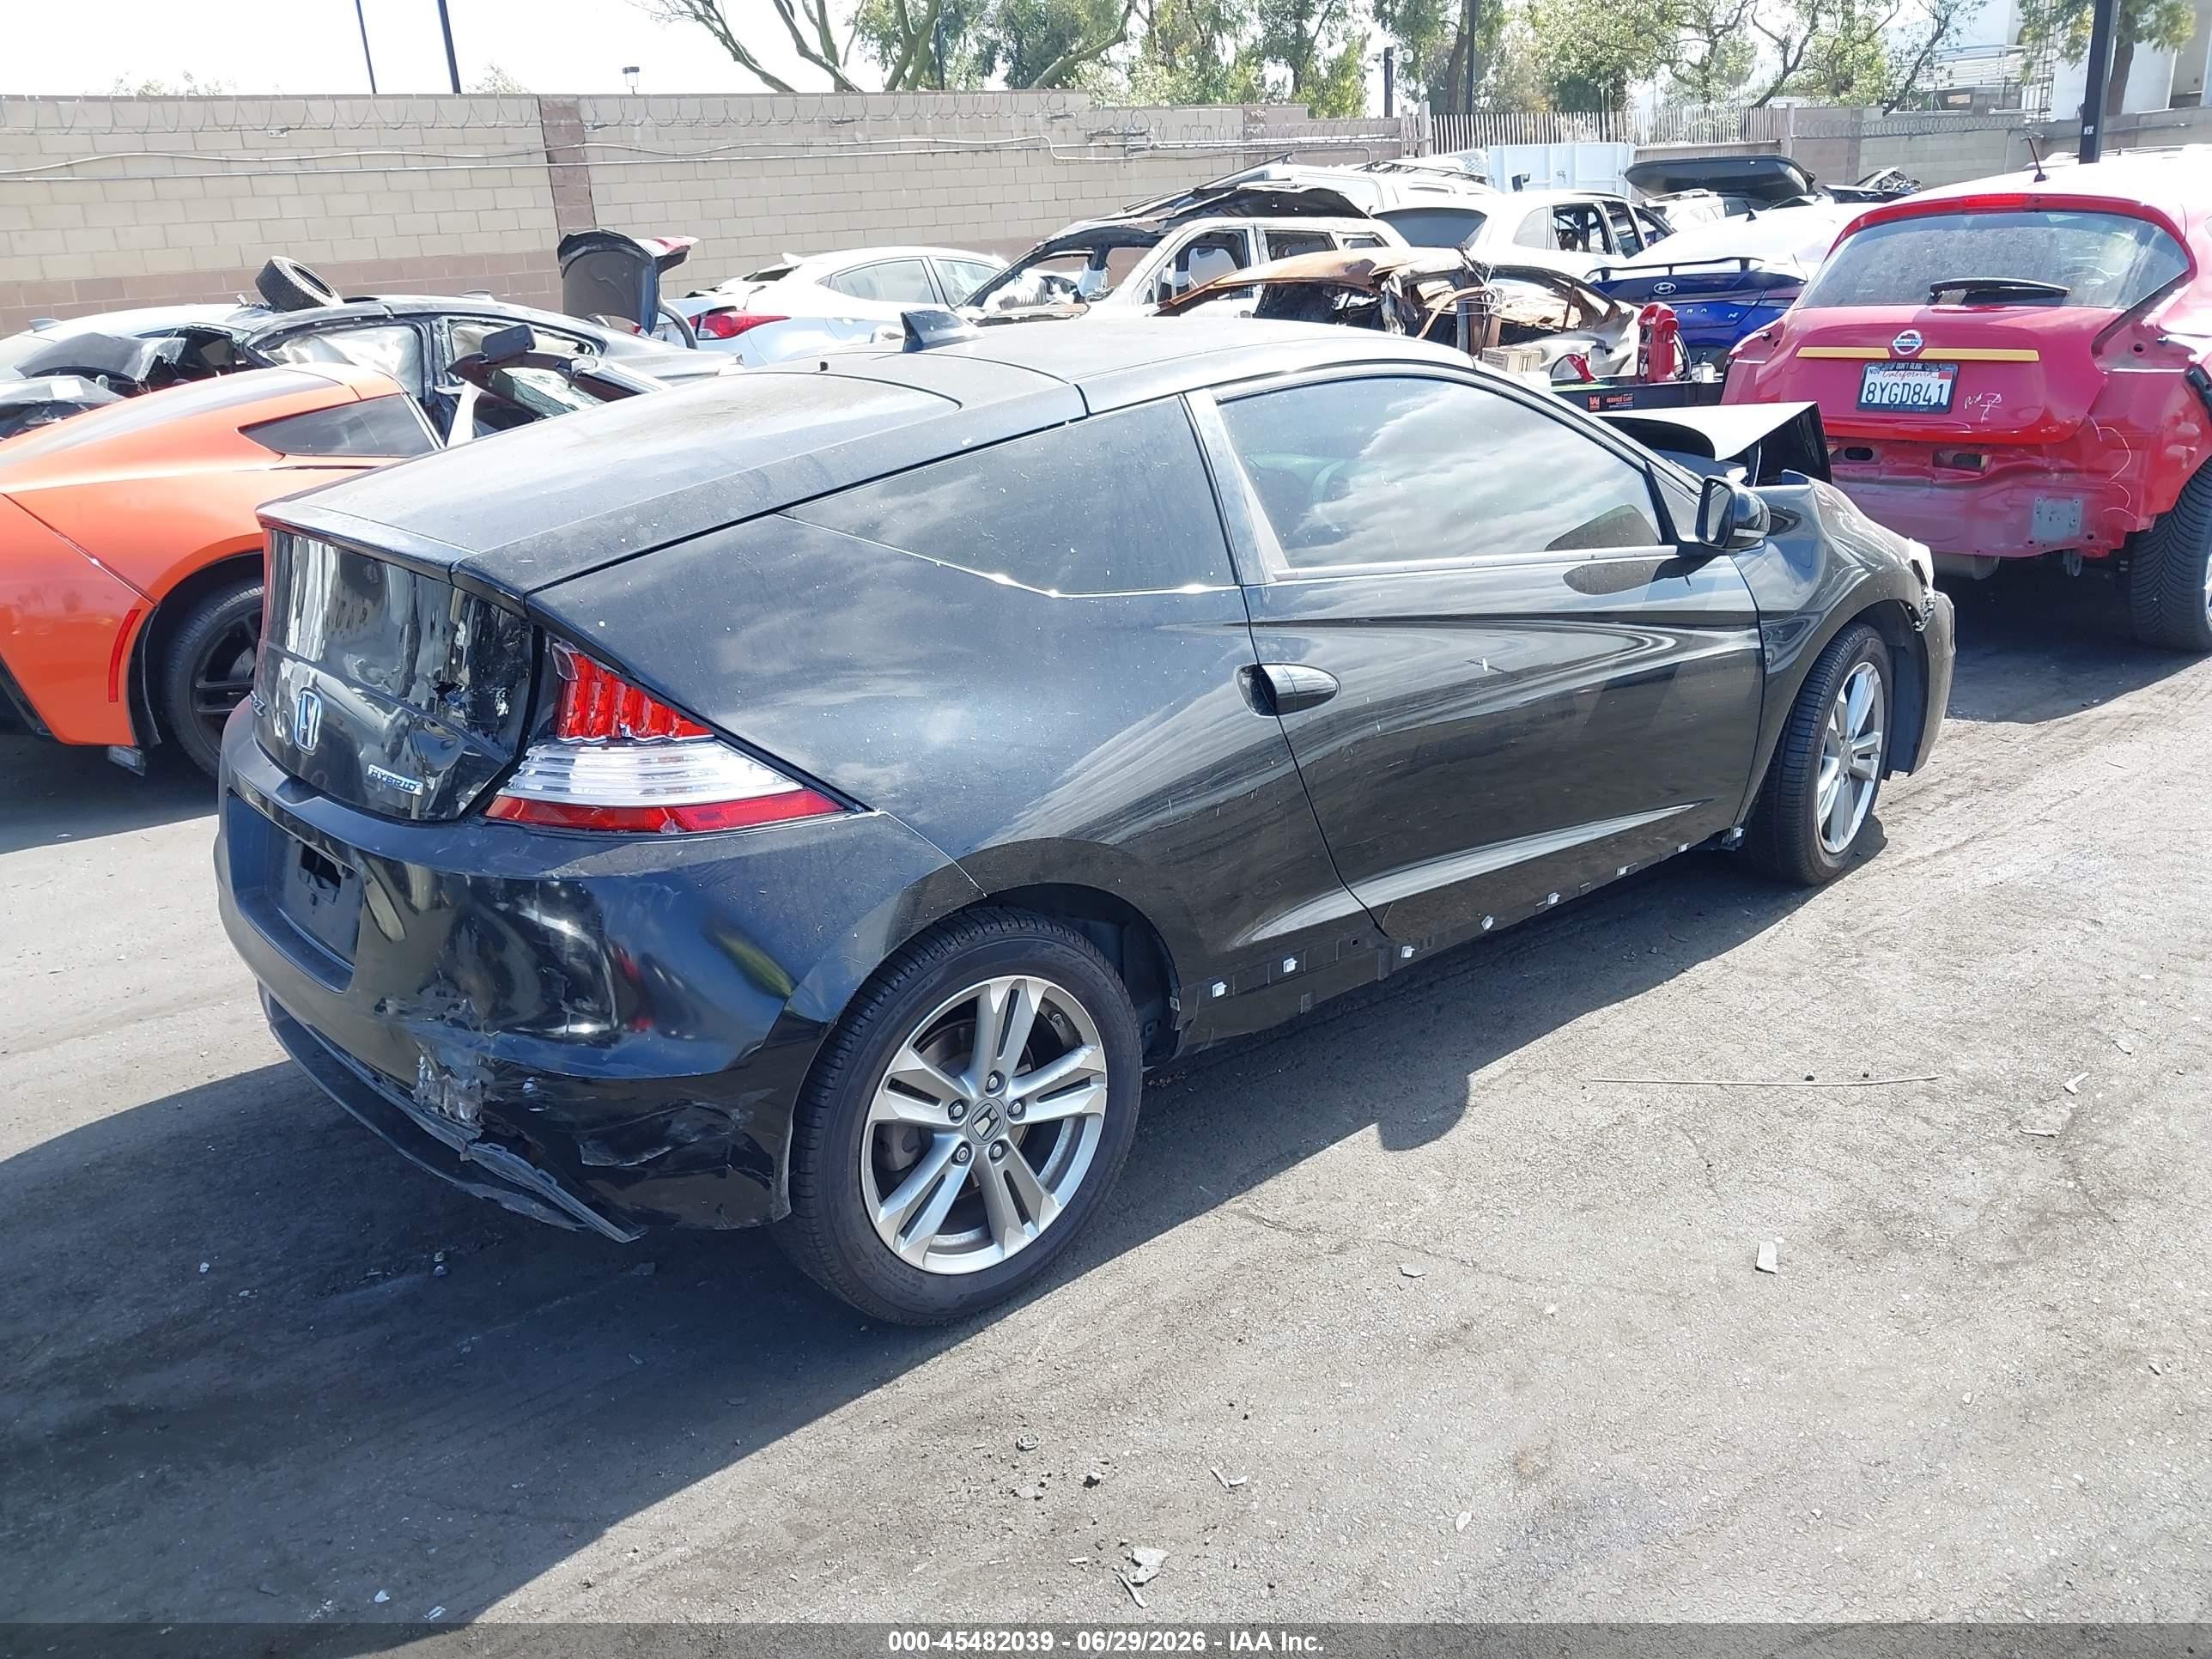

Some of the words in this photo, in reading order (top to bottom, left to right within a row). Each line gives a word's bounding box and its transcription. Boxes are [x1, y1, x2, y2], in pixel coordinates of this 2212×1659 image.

[1882, 370, 1932, 380] California
[1865, 381, 1944, 406] 8YGD841
[370, 767, 416, 791] HYBRID
